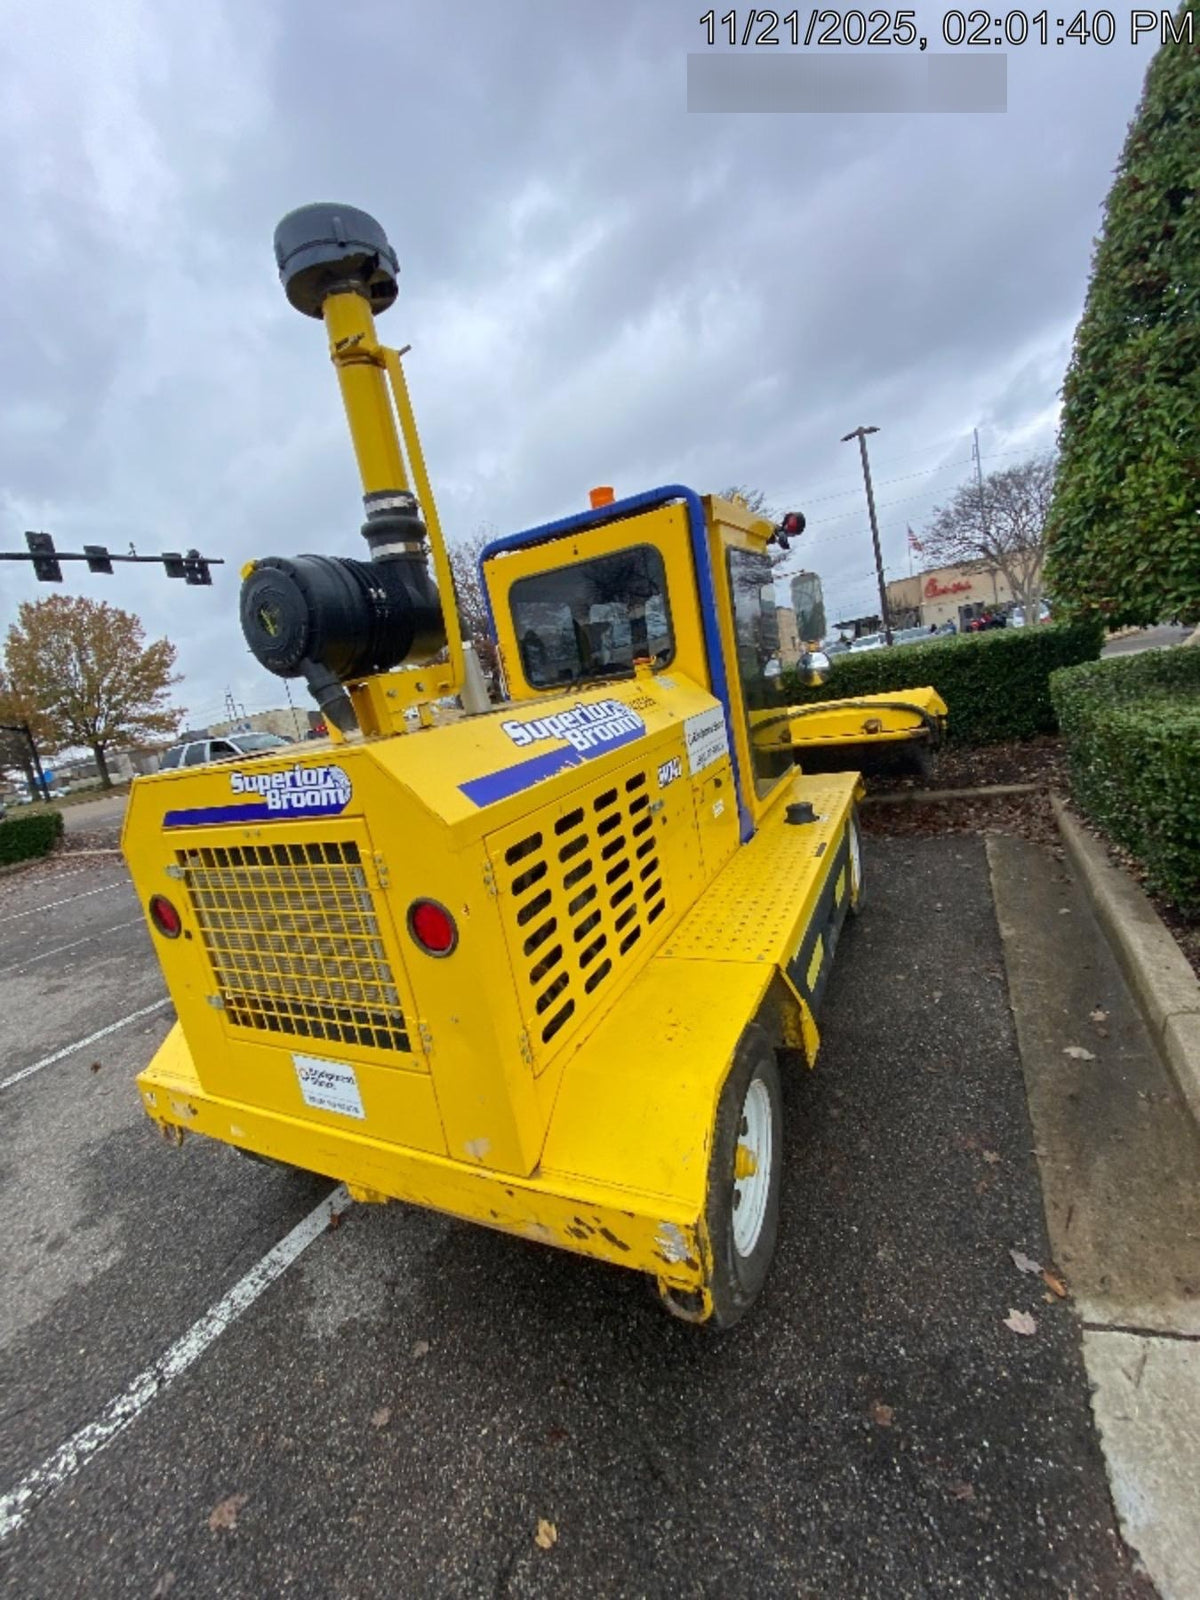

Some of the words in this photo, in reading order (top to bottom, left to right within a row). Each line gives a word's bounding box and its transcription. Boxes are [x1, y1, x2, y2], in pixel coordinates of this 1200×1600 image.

[500, 700, 621, 747] Superior
[564, 714, 643, 751] Broom
[230, 763, 331, 796] Superior
[266, 787, 347, 811] Broom
